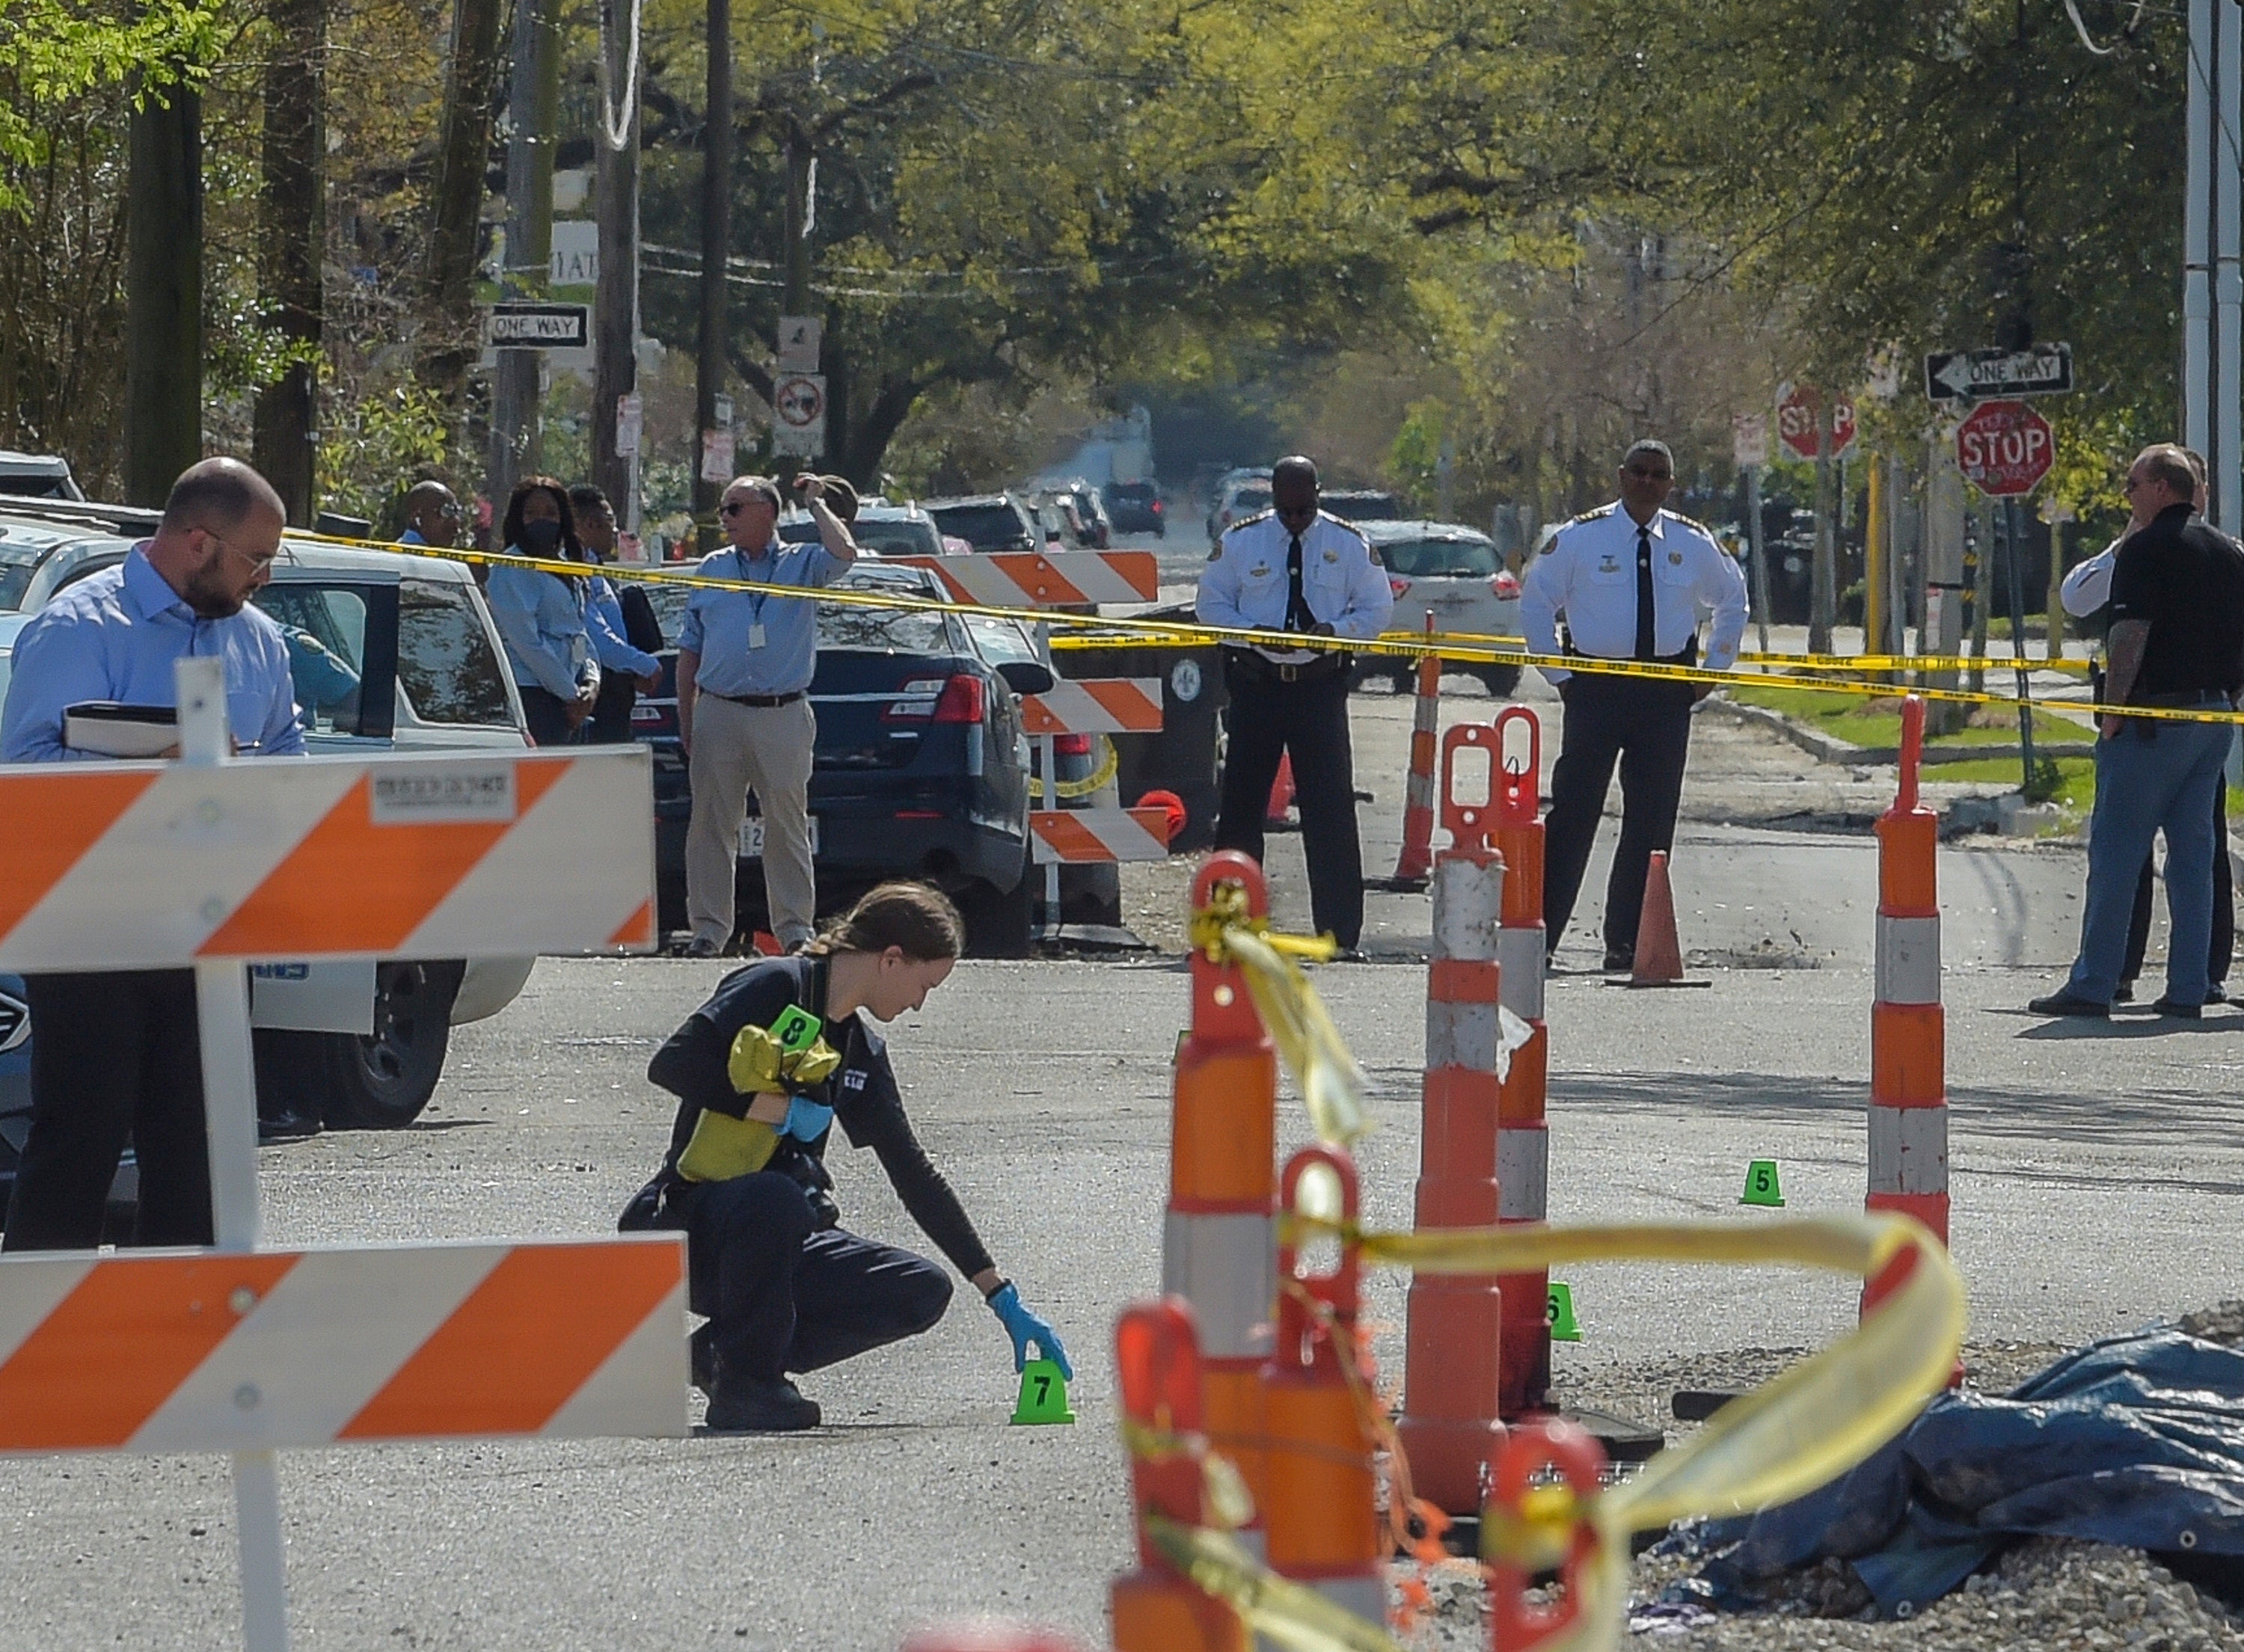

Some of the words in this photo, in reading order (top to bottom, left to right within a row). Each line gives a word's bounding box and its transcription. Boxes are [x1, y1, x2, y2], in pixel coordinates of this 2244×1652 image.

[495, 317, 530, 334] ONE
[536, 318, 574, 335] WAY
[1971, 361, 2007, 383] ONE
[2017, 357, 2057, 381] WAY
[1781, 405, 1854, 435] STP
[1964, 428, 2046, 467] STOP
[781, 1016, 807, 1045] 8
[1756, 1170, 1770, 1192] 5
[1548, 1295, 1560, 1322] 6
[1034, 1375, 1051, 1406] 7
